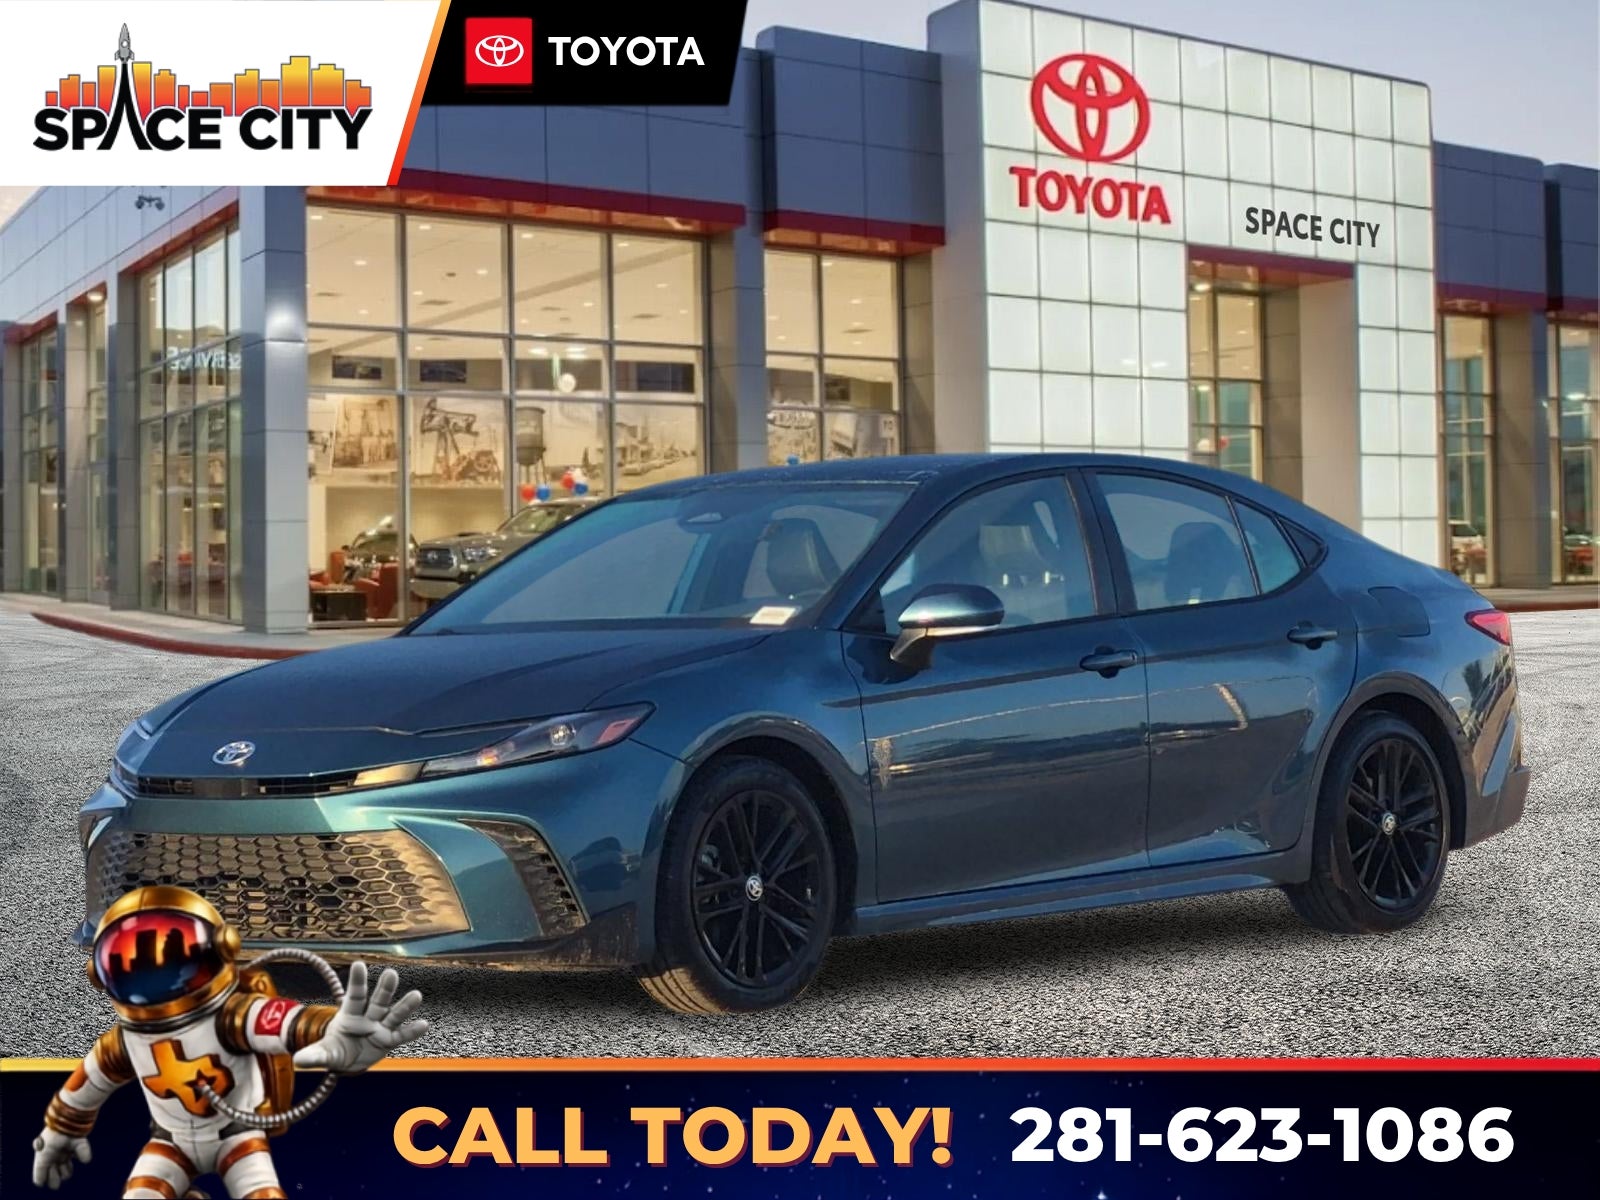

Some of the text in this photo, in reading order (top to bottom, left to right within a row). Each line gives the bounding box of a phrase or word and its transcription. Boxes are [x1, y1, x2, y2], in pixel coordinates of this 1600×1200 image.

[1009, 166, 1171, 225] TOYOTA
[1245, 206, 1381, 248] SPACE CITY
